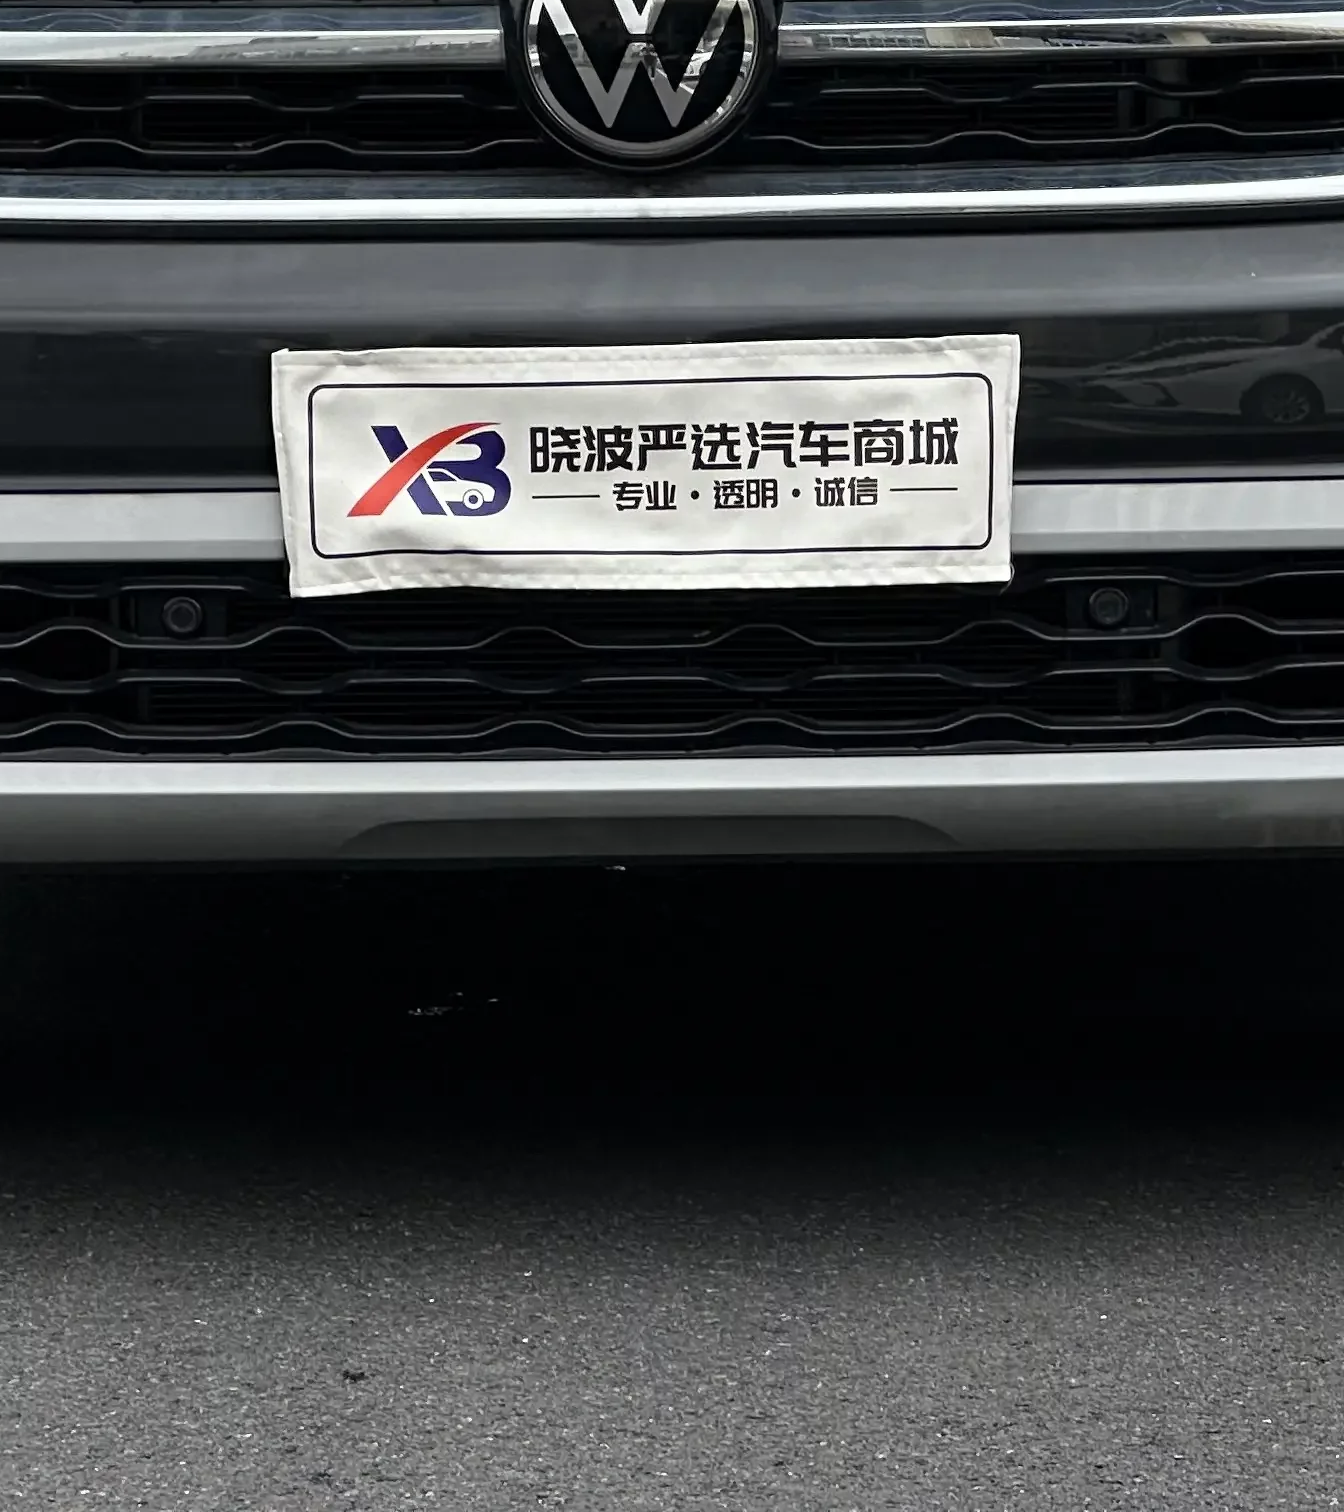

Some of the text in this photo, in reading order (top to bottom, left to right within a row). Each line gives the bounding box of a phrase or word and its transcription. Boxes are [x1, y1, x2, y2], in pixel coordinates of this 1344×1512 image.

[529, 417, 960, 473] 晓波严选汽车商城
